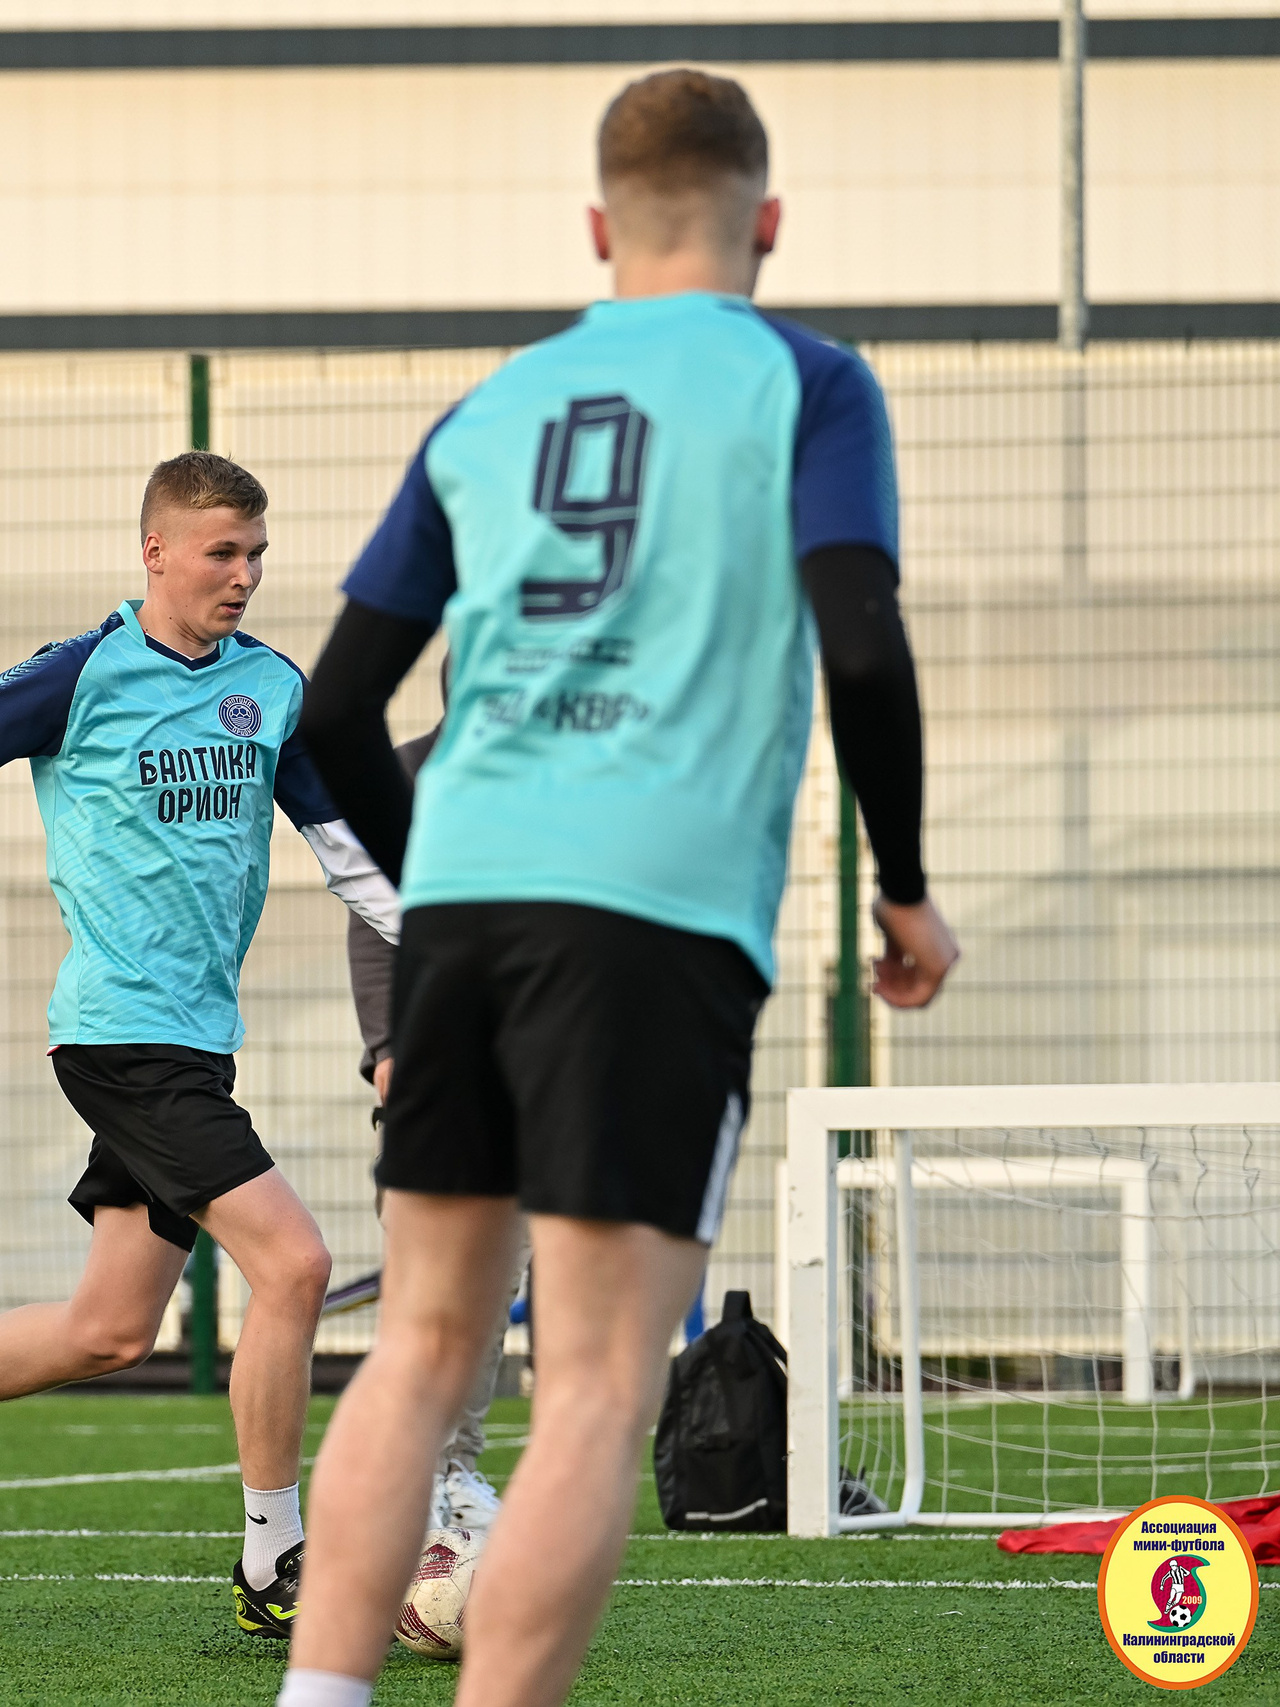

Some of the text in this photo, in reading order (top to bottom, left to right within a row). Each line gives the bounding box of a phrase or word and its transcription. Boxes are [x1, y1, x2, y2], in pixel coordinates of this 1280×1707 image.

[520, 396, 651, 621] 9
[138, 743, 257, 786] БАЛТИКА
[157, 783, 244, 824] ОРИОН
